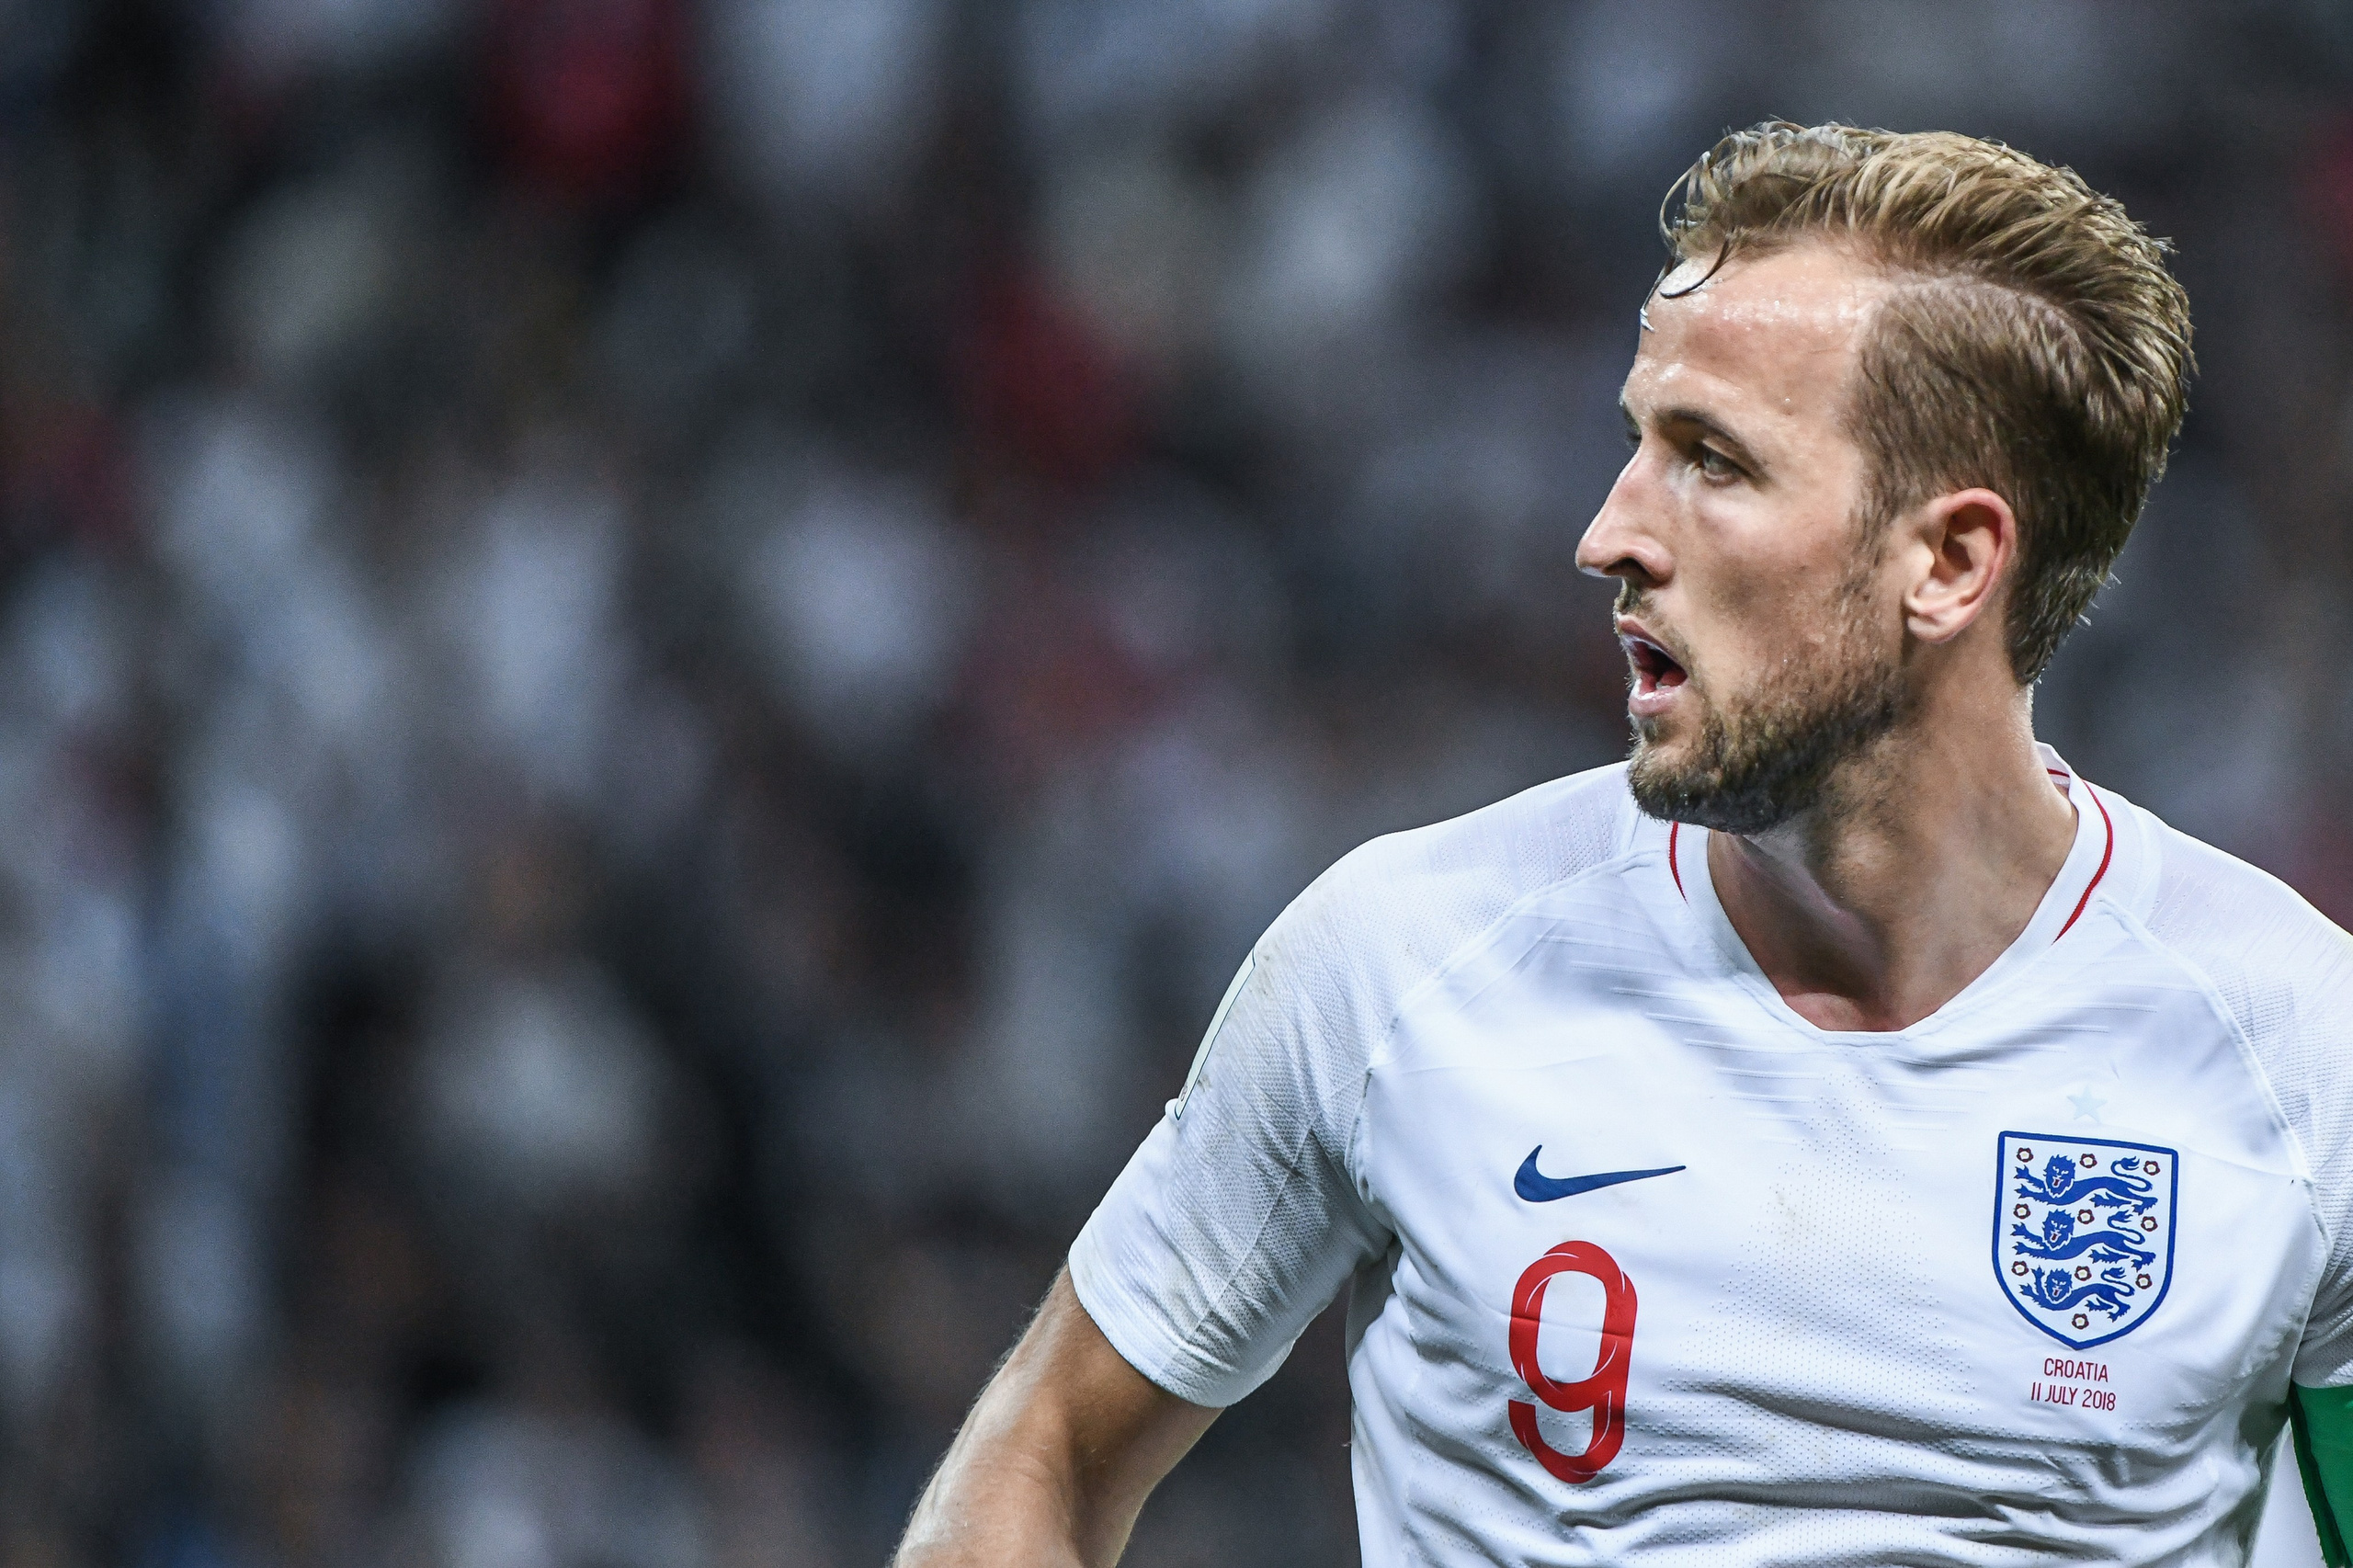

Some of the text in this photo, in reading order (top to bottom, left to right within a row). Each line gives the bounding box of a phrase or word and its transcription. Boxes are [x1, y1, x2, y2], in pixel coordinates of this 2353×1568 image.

[1508, 1240, 1638, 1484] 9
[2043, 1358, 2109, 1382] CROATIA
[2030, 1381, 2117, 1412] 11 JULY 2018
